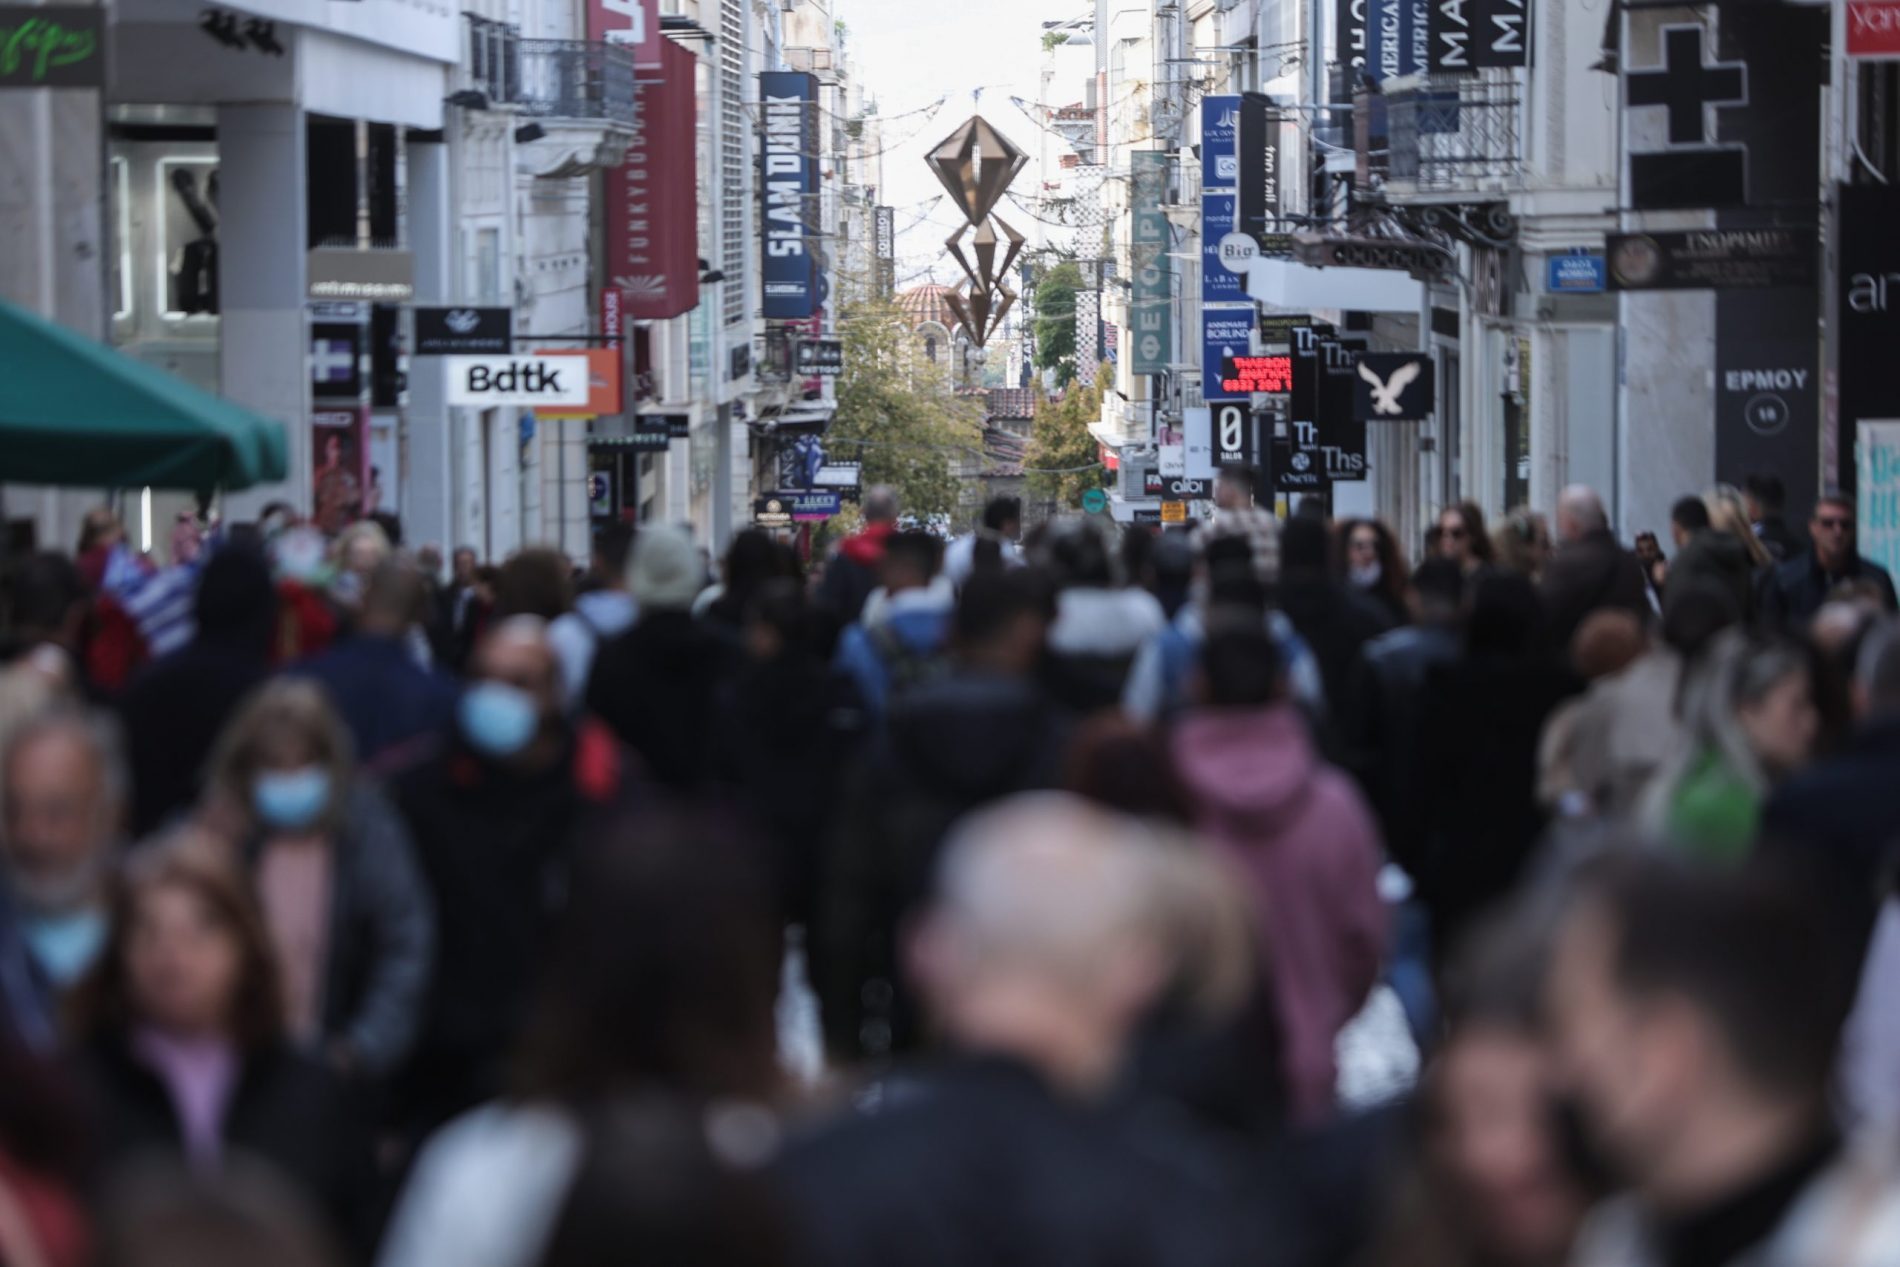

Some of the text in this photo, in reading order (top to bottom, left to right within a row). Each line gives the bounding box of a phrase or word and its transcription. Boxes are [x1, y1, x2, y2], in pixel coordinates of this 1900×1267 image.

[1491, 0, 1523, 51] M
[766, 95, 803, 257] SLAM DUNK
[1320, 446, 1363, 471] Ths
